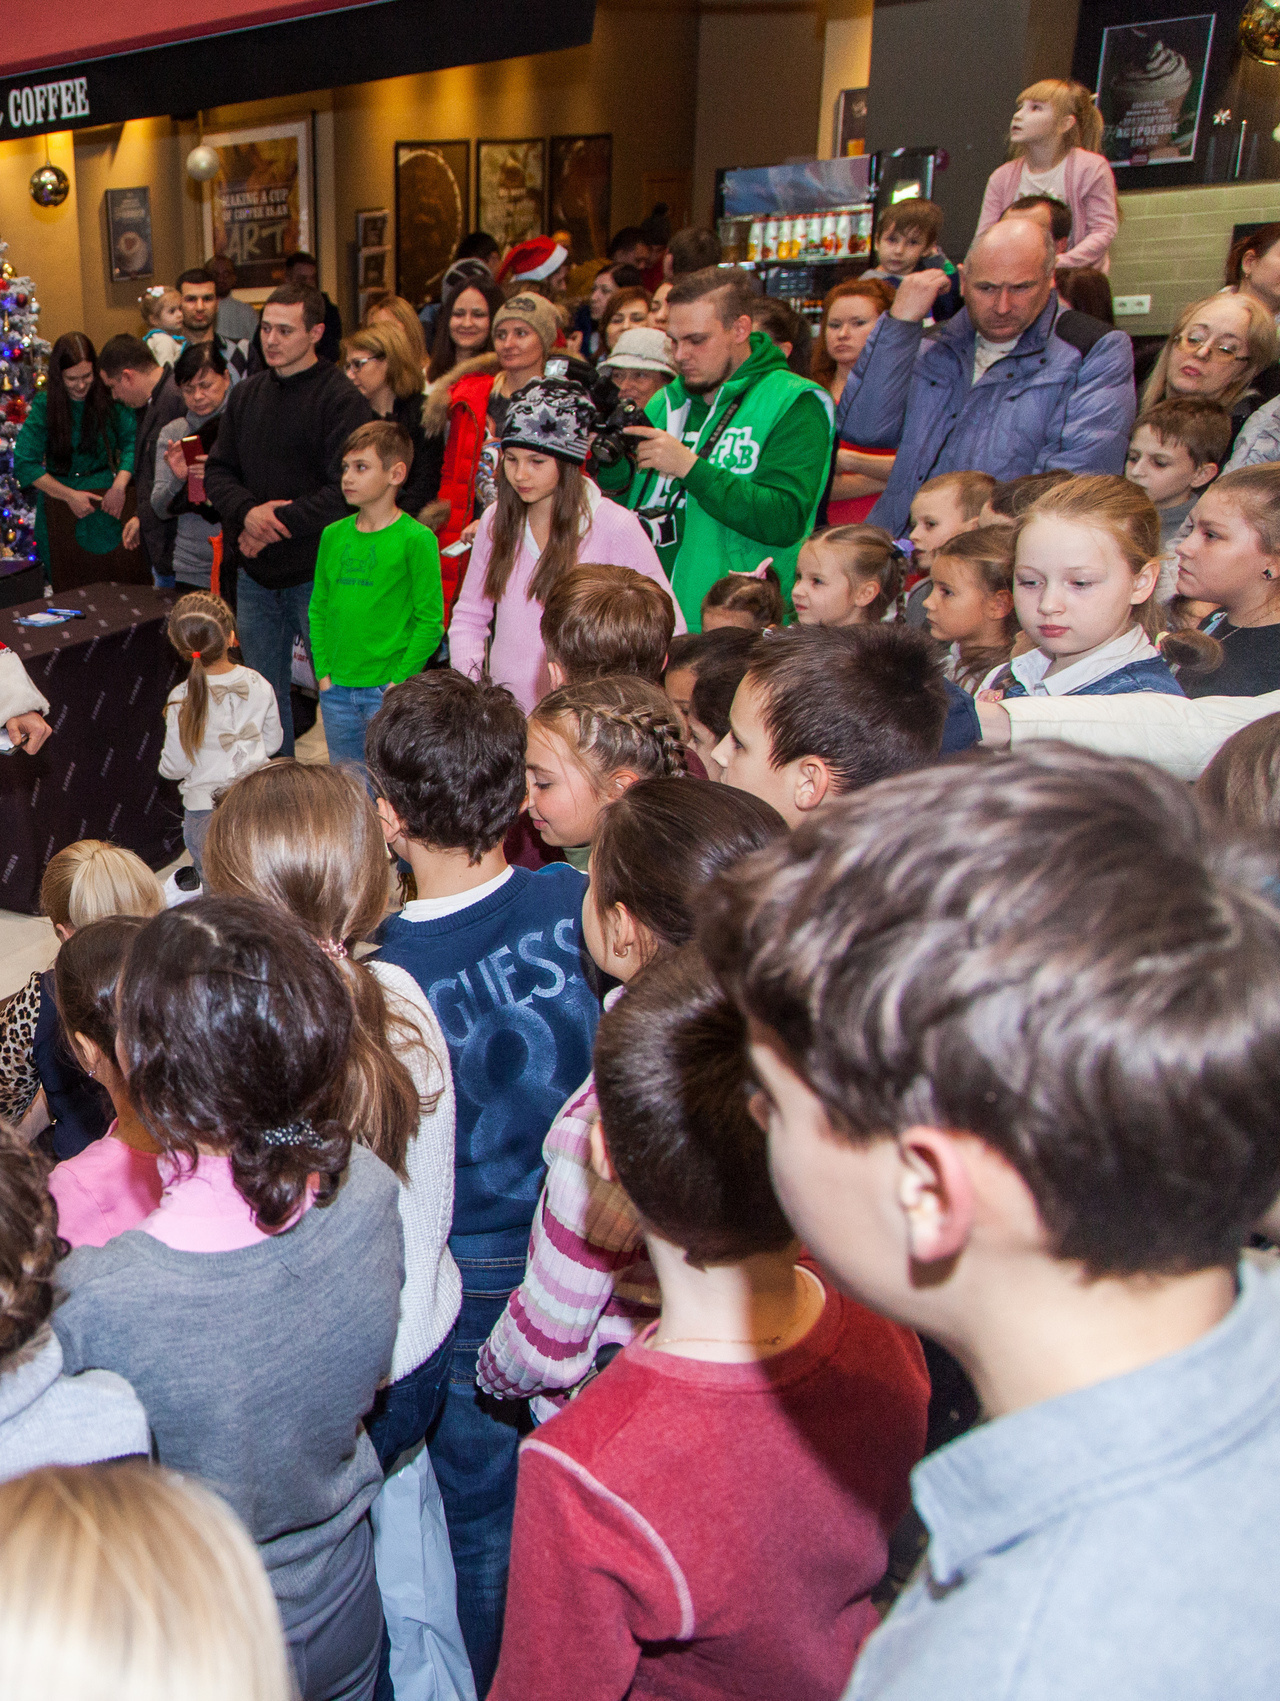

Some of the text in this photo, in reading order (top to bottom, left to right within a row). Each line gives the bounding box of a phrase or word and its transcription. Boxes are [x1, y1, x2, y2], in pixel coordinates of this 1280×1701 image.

[8, 76, 91, 129] COFFEE
[227, 222, 287, 265] ART
[427, 918, 581, 1047] GUESS
